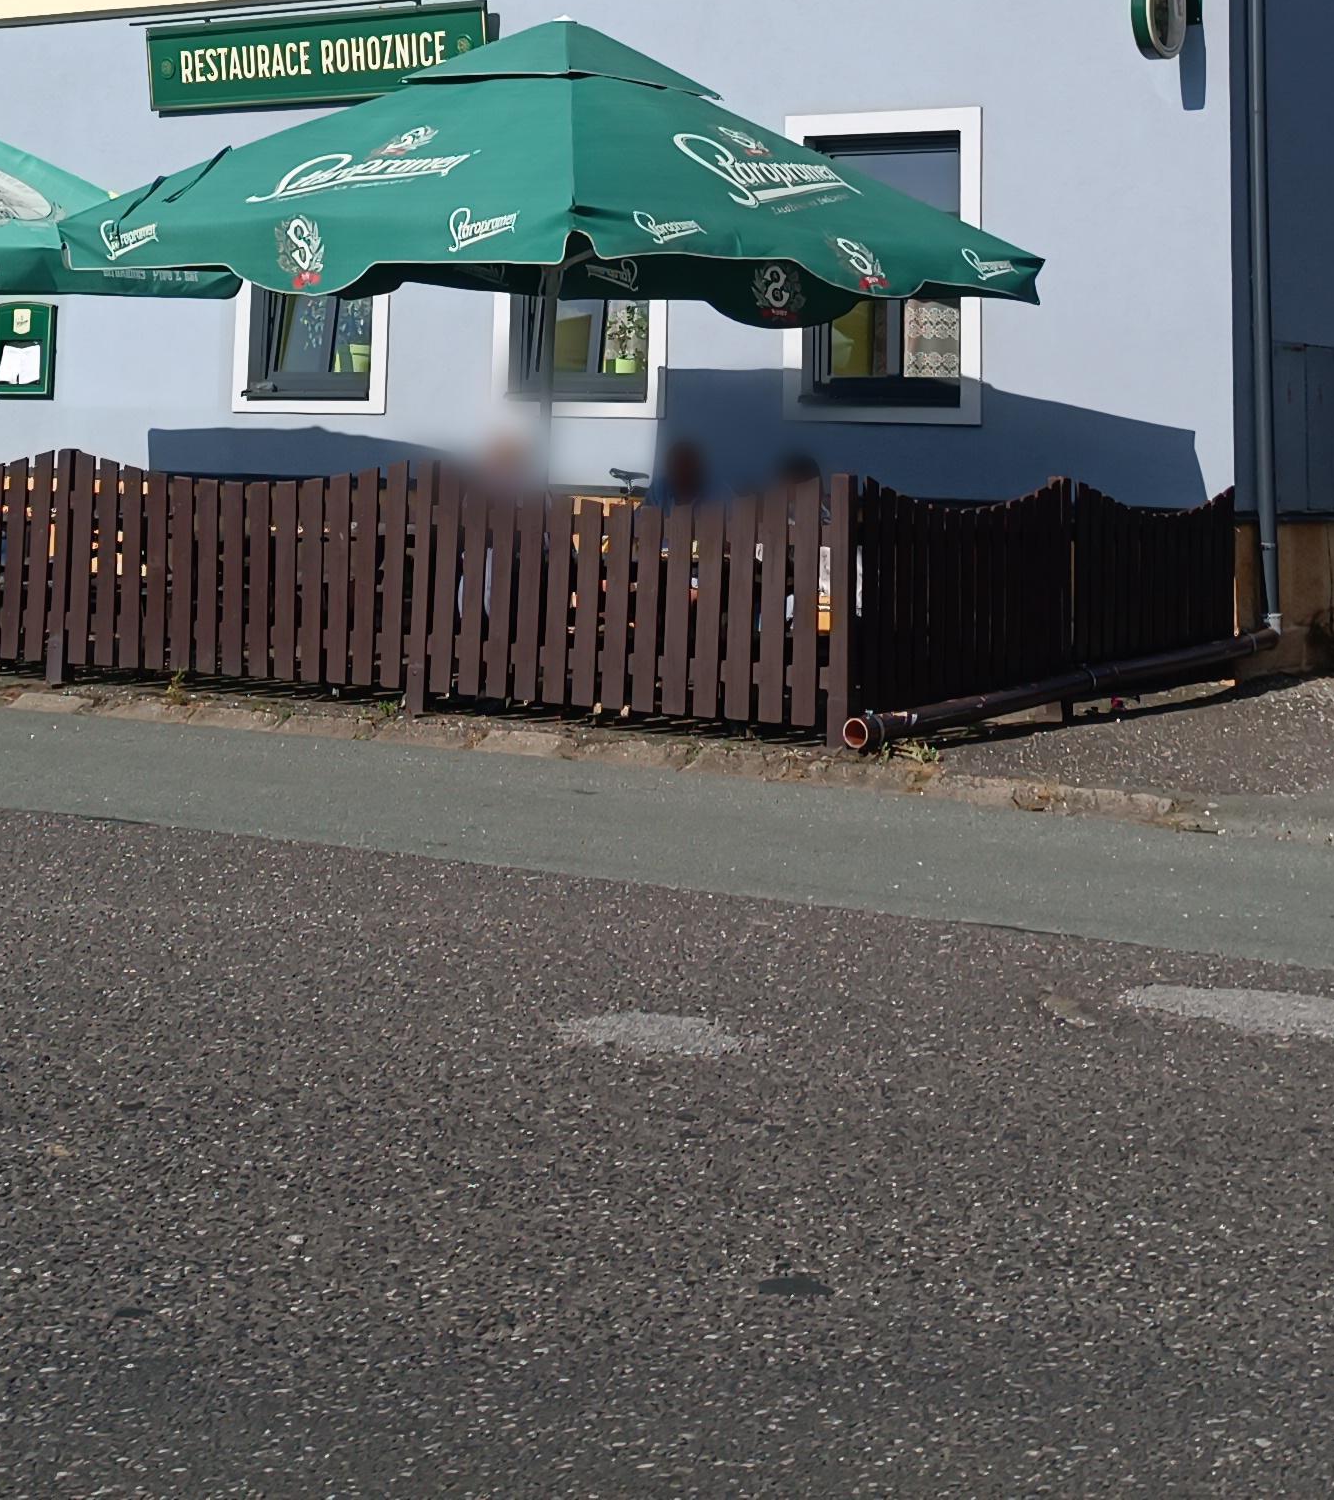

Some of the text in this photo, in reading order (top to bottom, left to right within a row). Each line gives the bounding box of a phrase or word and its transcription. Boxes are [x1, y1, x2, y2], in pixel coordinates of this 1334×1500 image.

[180, 30, 448, 84] RESTAURACE ROHOZNICE
[245, 153, 473, 203] Staropramen
[673, 133, 864, 208] Staropramen
[447, 207, 518, 252] Staropramen
